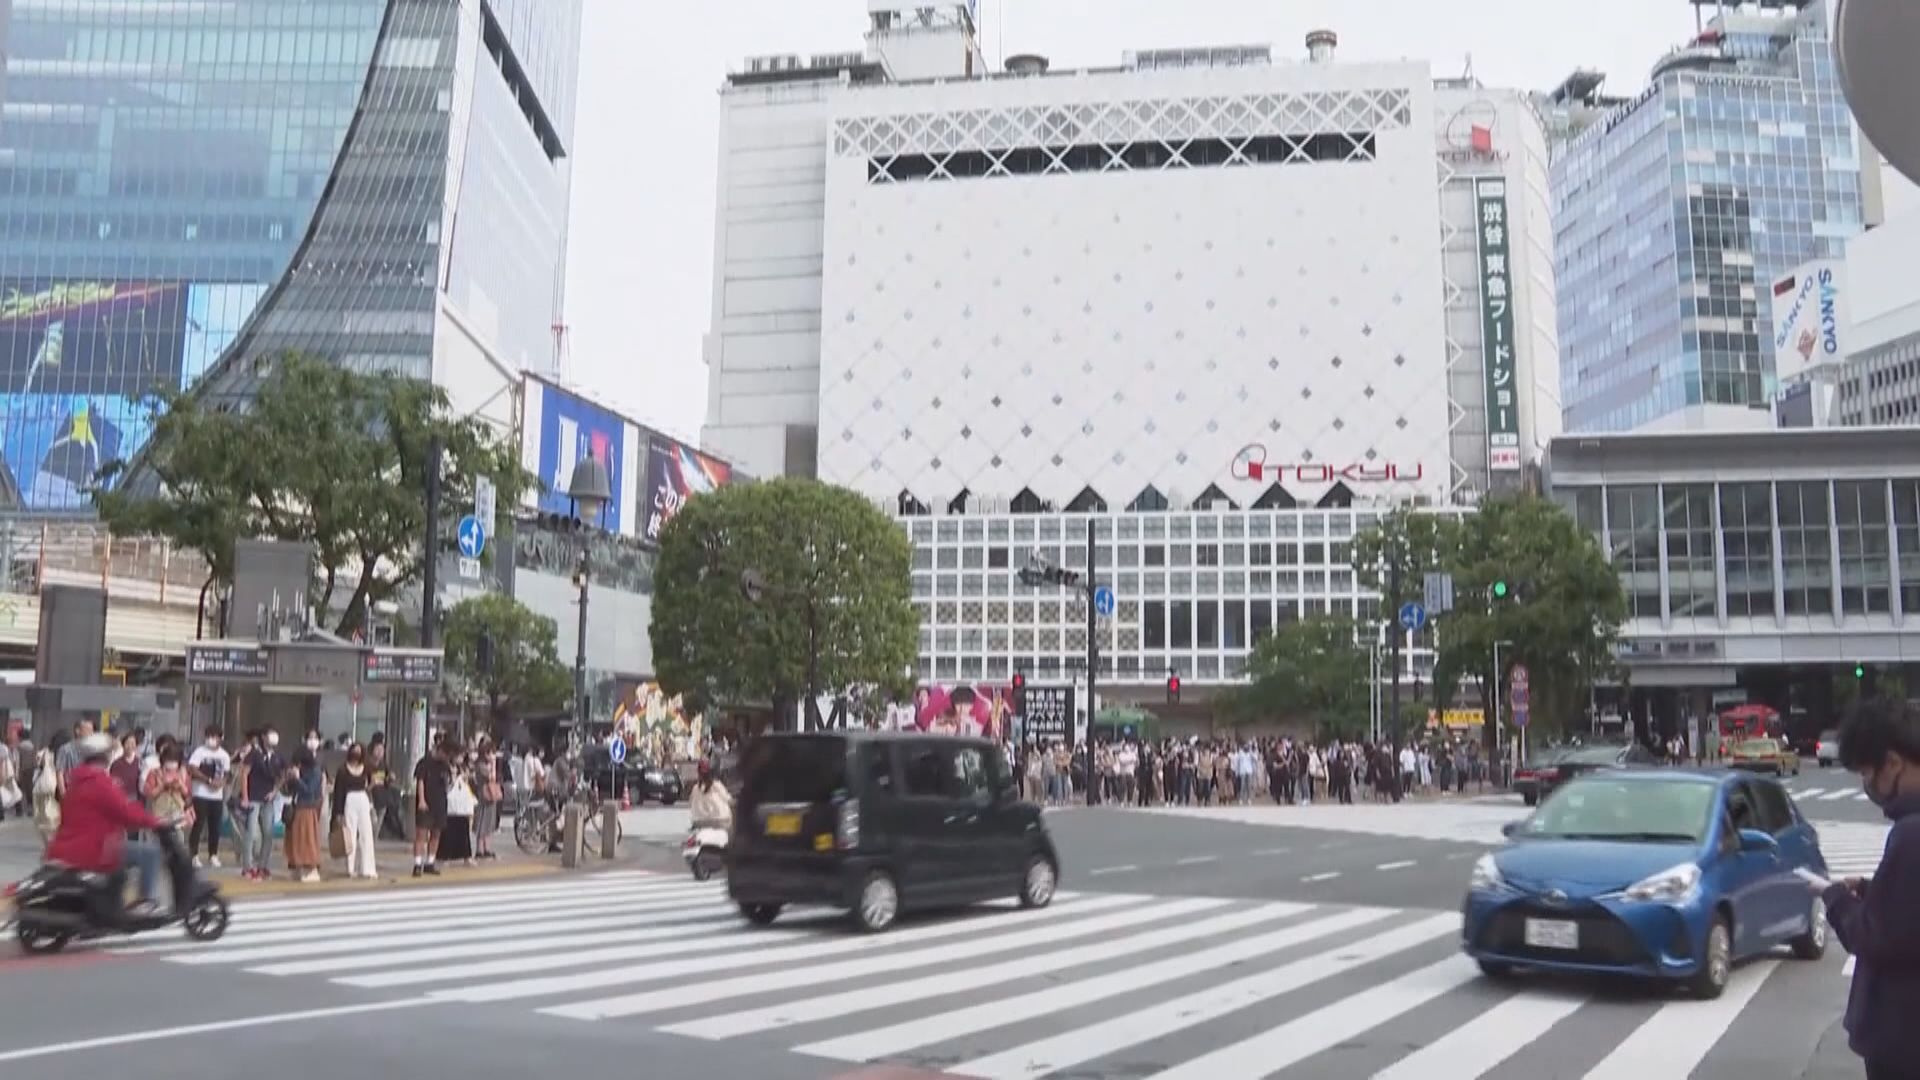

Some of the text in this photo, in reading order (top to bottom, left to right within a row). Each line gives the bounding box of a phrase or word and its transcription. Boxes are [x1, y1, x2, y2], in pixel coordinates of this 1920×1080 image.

[1484, 202, 1503, 245] 渋谷
[1486, 254, 1512, 430] 東急フードショー
[1777, 275, 1814, 349] SANKYO
[1818, 267, 1838, 355] SANKYO
[1264, 463, 1422, 482] TOKYU
